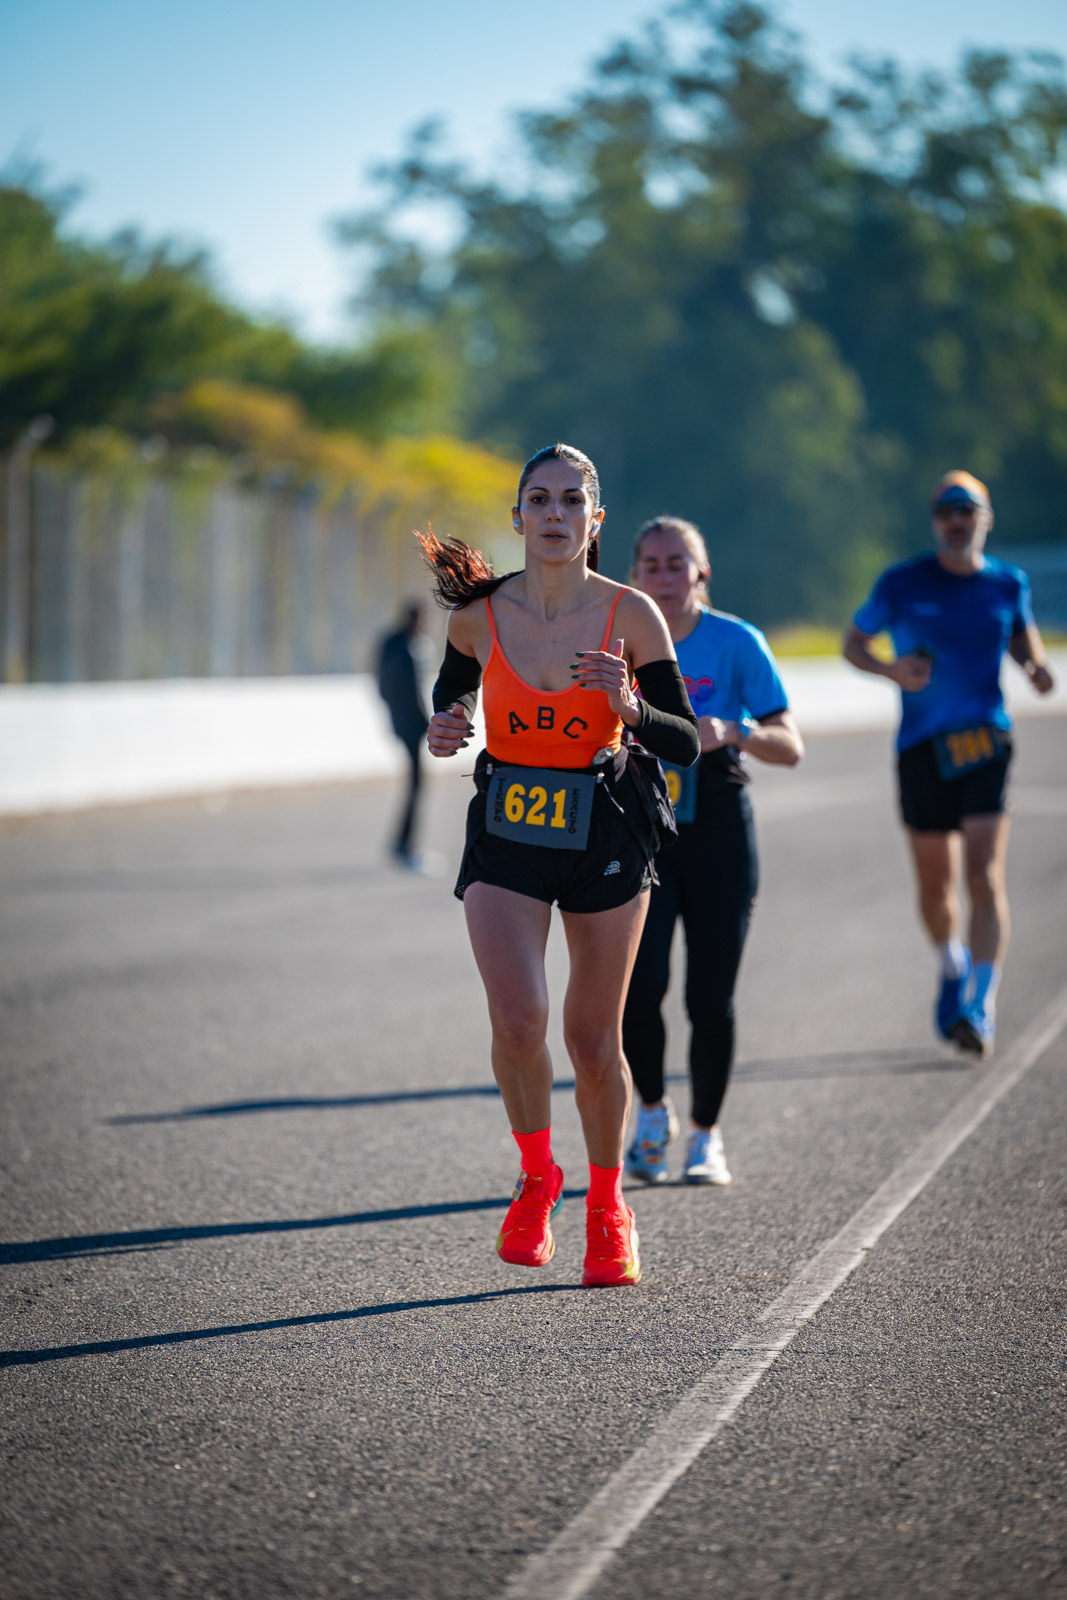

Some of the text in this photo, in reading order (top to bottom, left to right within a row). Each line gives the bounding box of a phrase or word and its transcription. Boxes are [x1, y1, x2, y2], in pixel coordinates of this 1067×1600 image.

[494, 778, 506, 823] TIEMPO
[505, 783, 566, 829] 621
[568, 788, 581, 834] EXACTO
